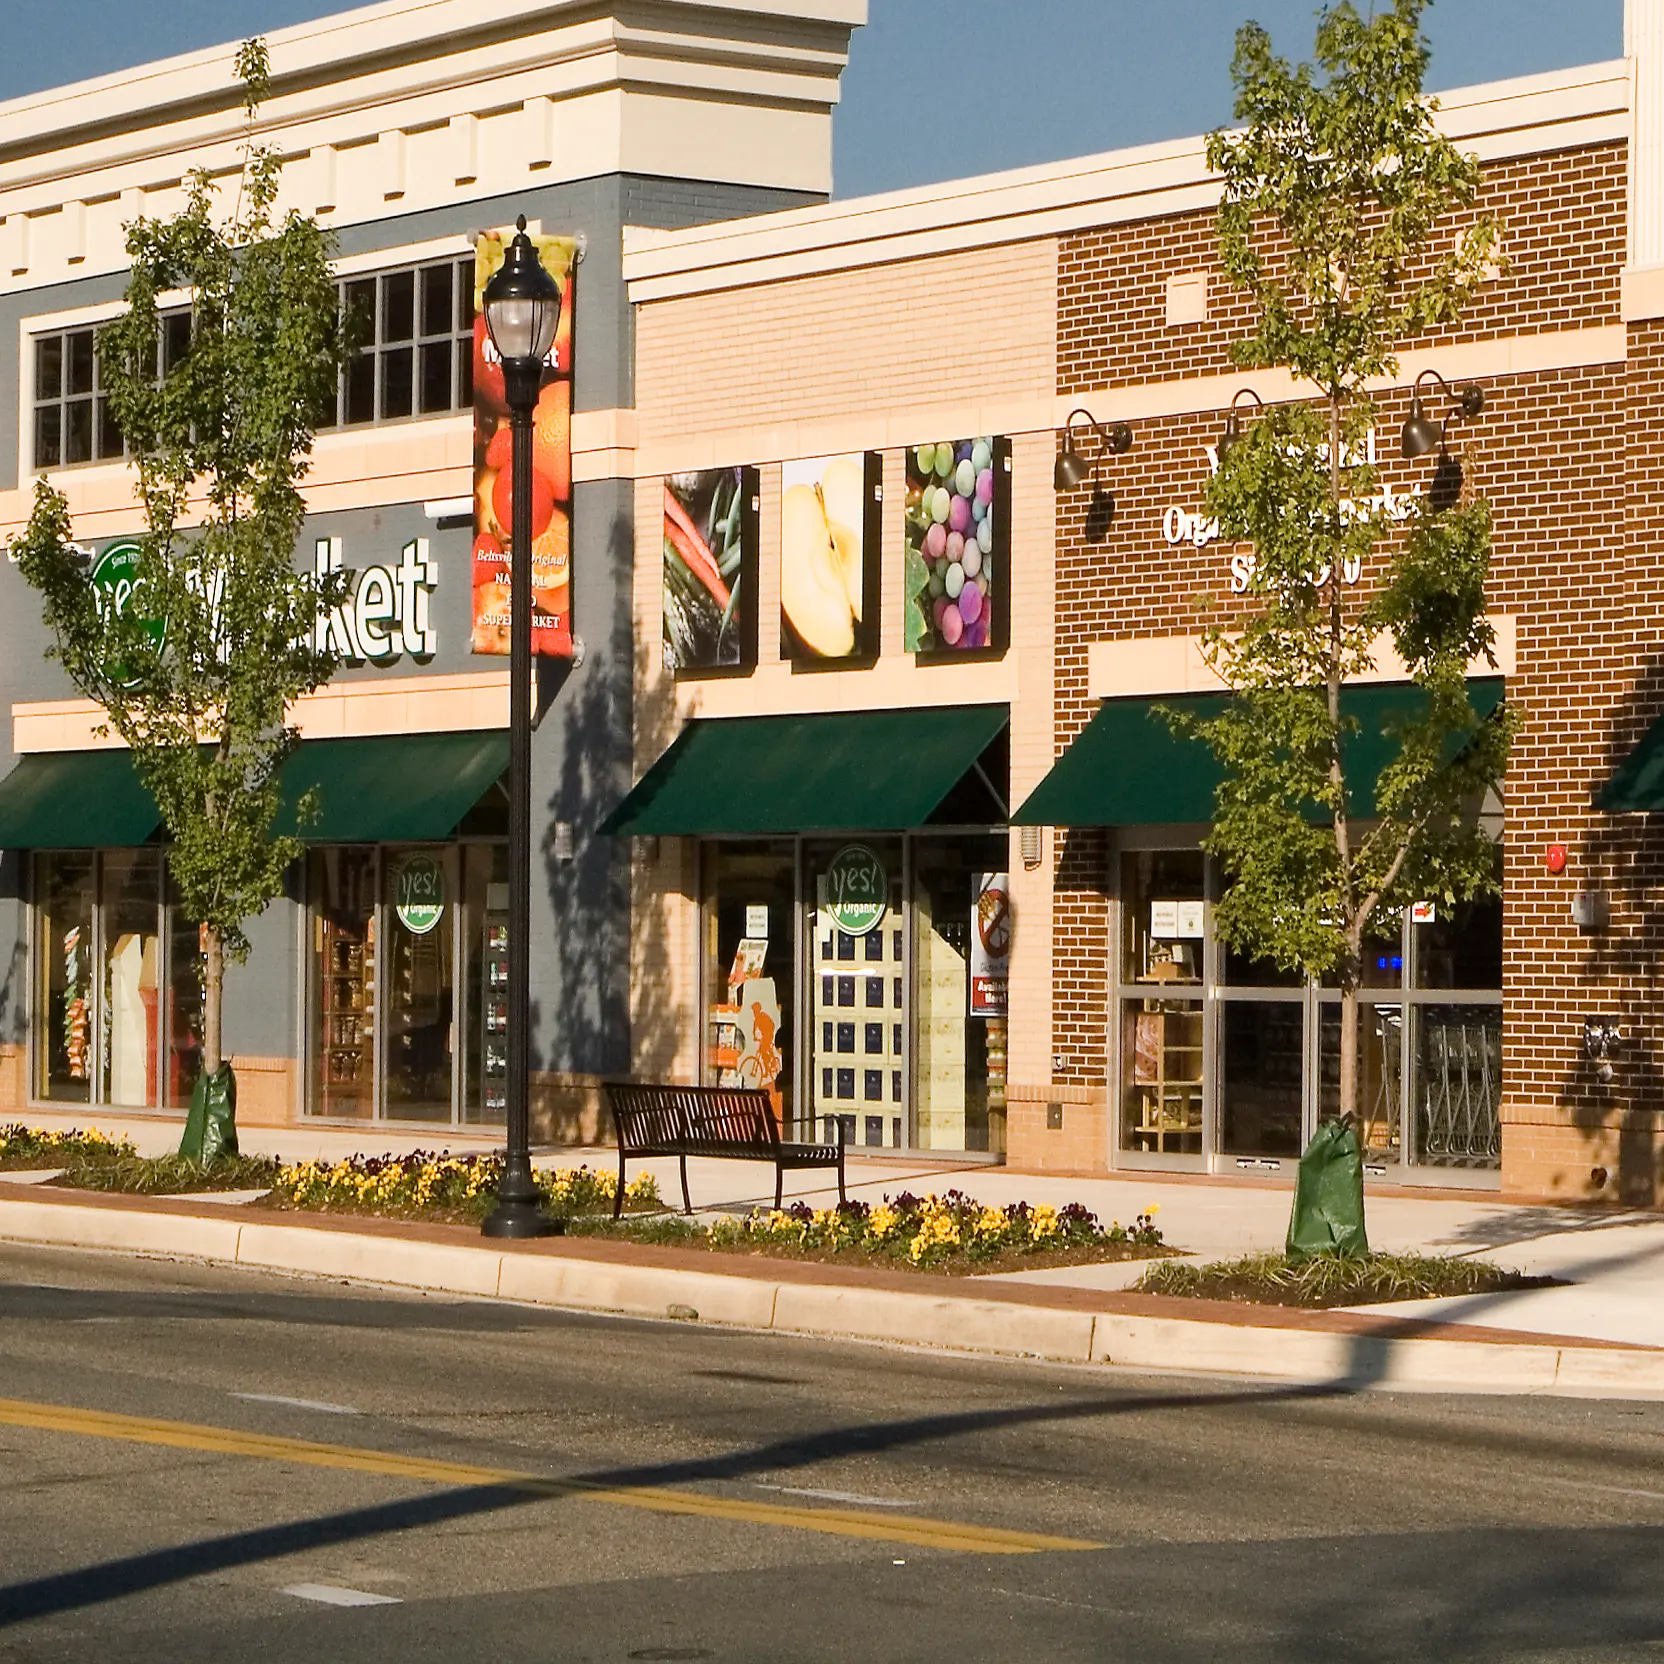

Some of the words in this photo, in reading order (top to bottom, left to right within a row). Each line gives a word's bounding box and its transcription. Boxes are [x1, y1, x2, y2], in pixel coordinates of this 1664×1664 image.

[483, 614, 561, 629] SUPERKET
[832, 863, 877, 918] yes!
[842, 901, 877, 918] Organic
